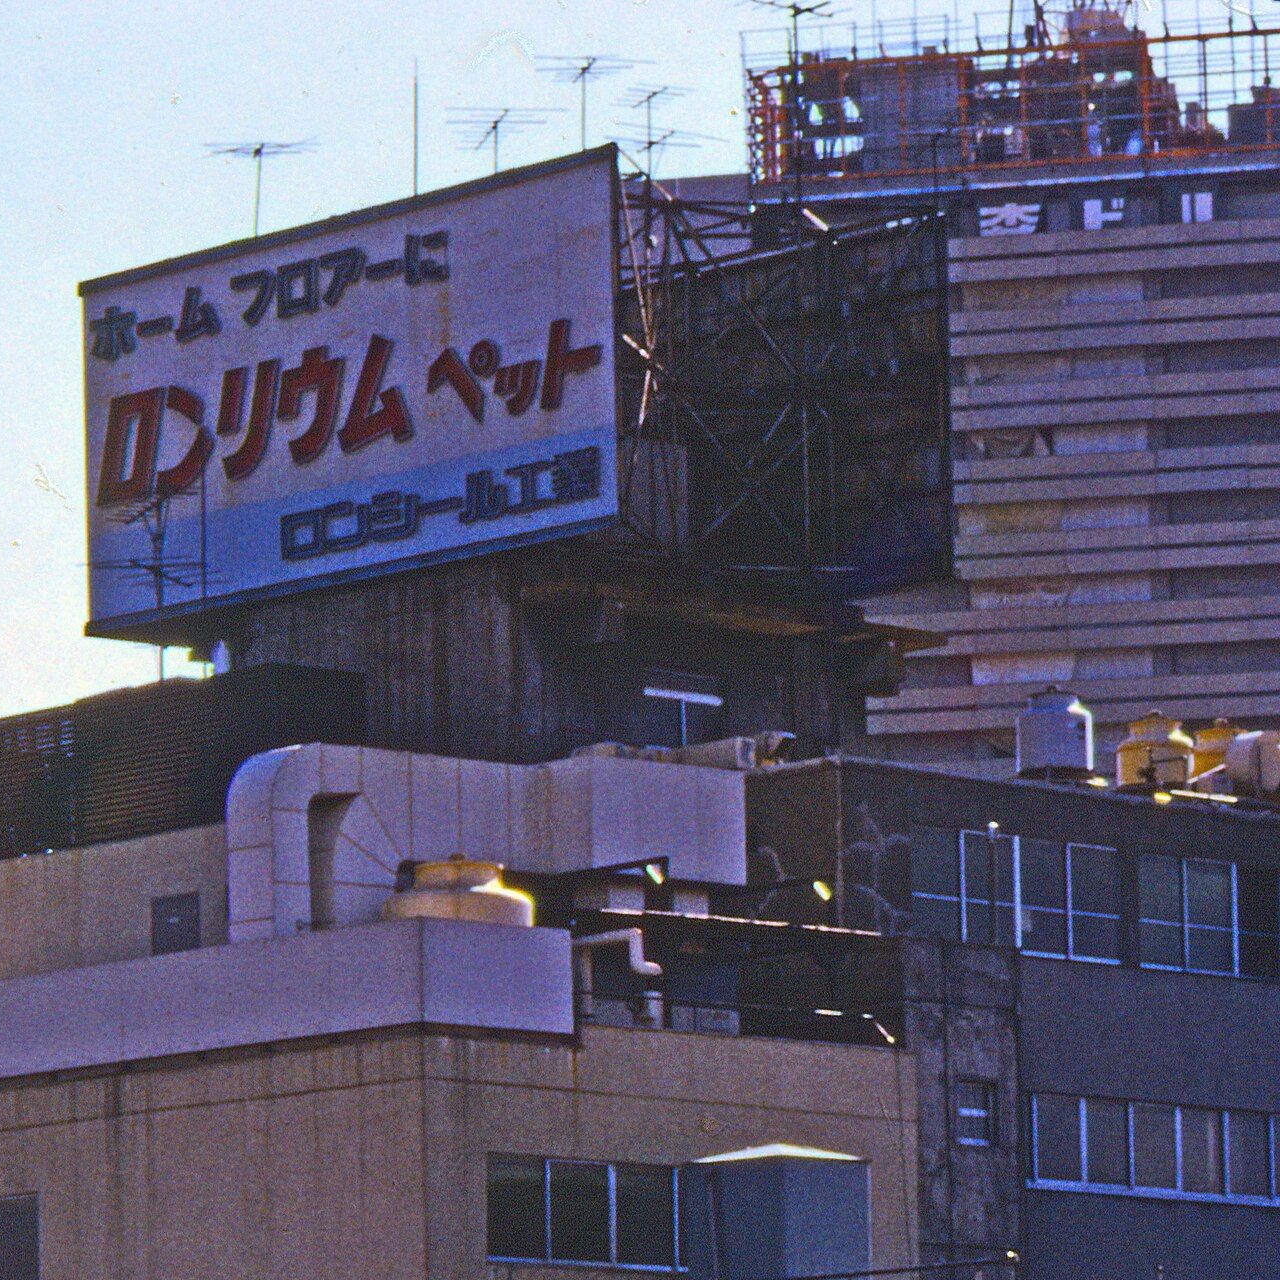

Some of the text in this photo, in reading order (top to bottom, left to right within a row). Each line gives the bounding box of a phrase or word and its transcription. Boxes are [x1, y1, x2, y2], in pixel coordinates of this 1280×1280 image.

[89, 231, 450, 361] ホーム フロアーに
[425, 319, 603, 423] ペット
